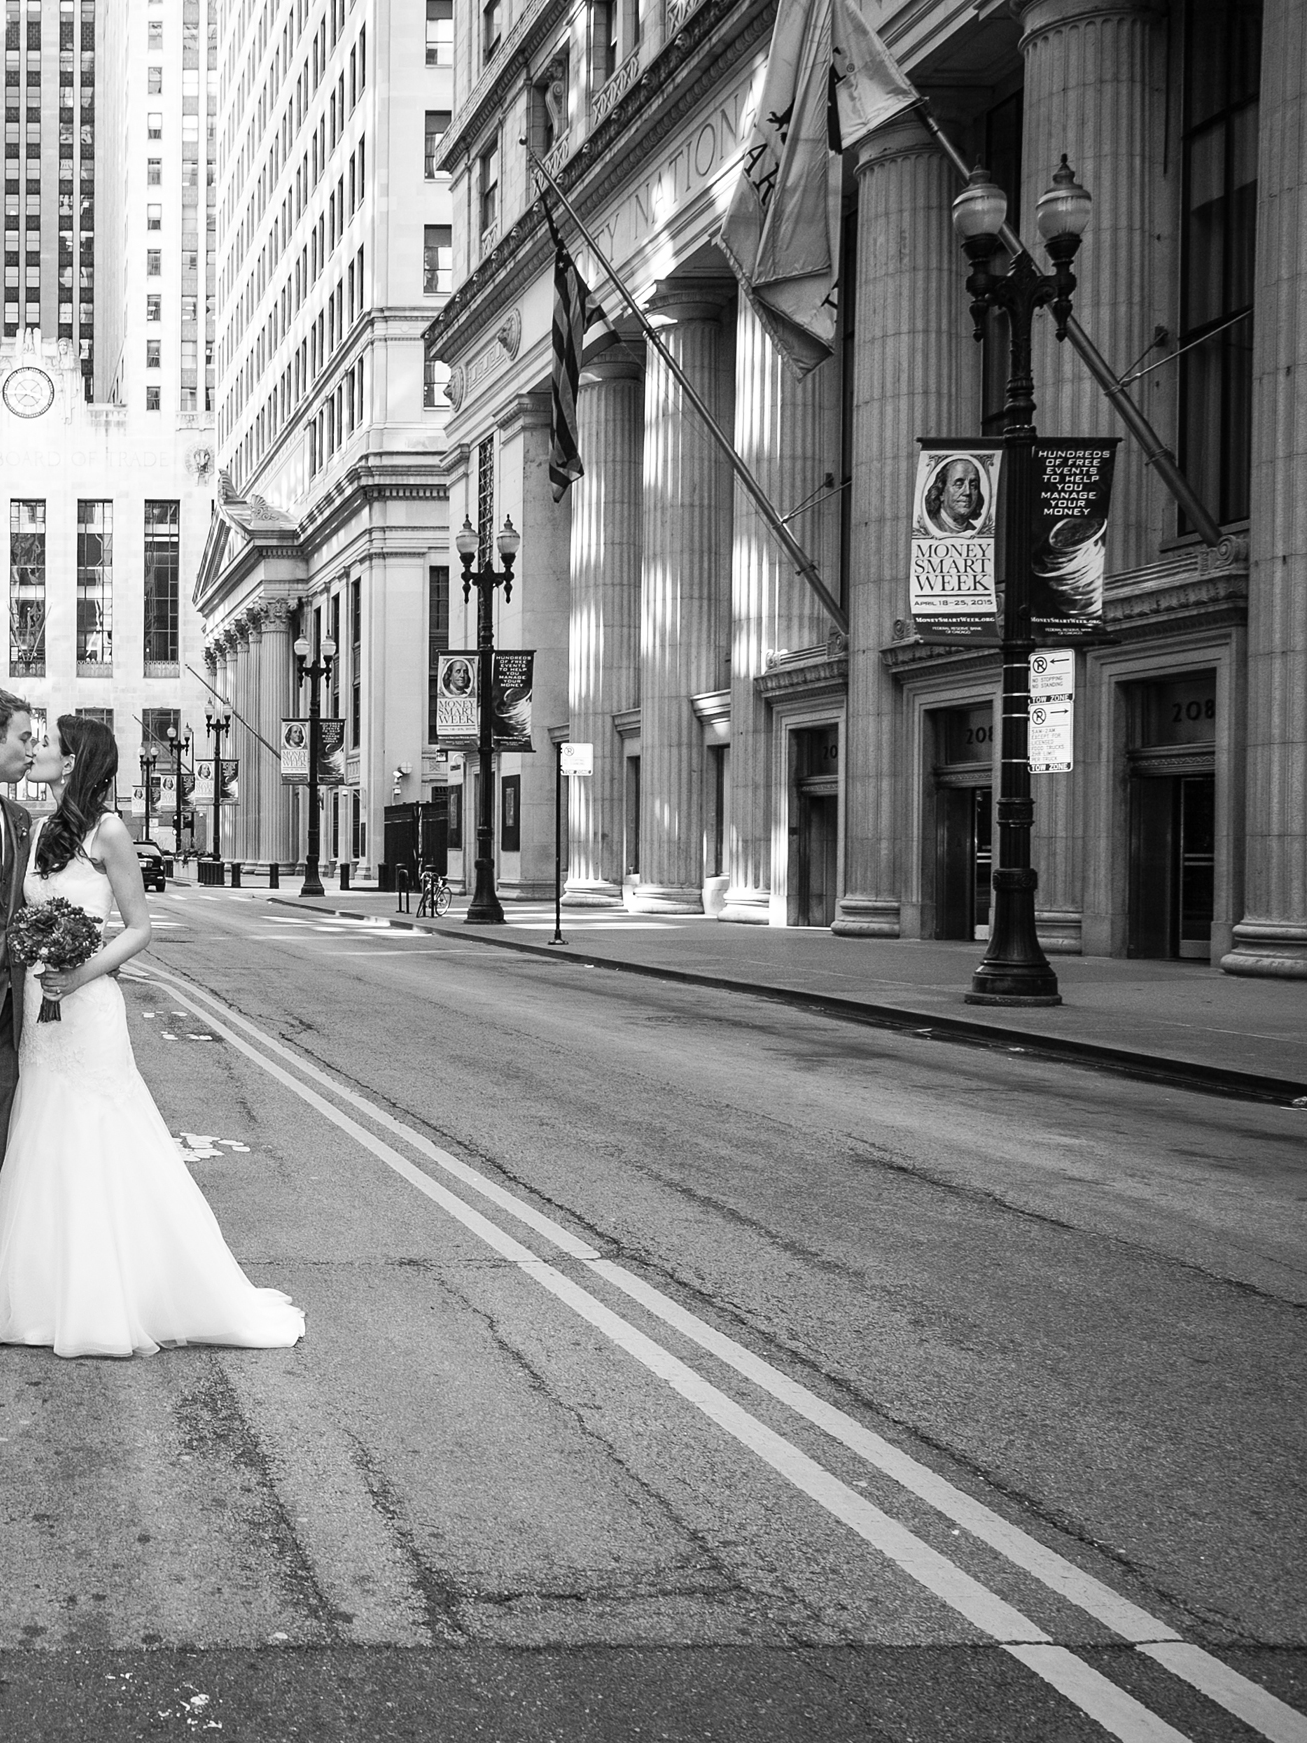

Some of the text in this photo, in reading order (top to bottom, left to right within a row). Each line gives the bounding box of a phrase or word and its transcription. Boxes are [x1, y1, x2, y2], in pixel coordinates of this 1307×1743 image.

[634, 80, 756, 240] NATIONA
[72, 450, 95, 468] OF
[108, 450, 169, 468] TRADE
[916, 544, 991, 558] MONEY
[914, 558, 990, 574] SMART
[914, 574, 990, 591] WEEK
[1172, 699, 1215, 722] 208
[439, 716, 475, 724] WEEK
